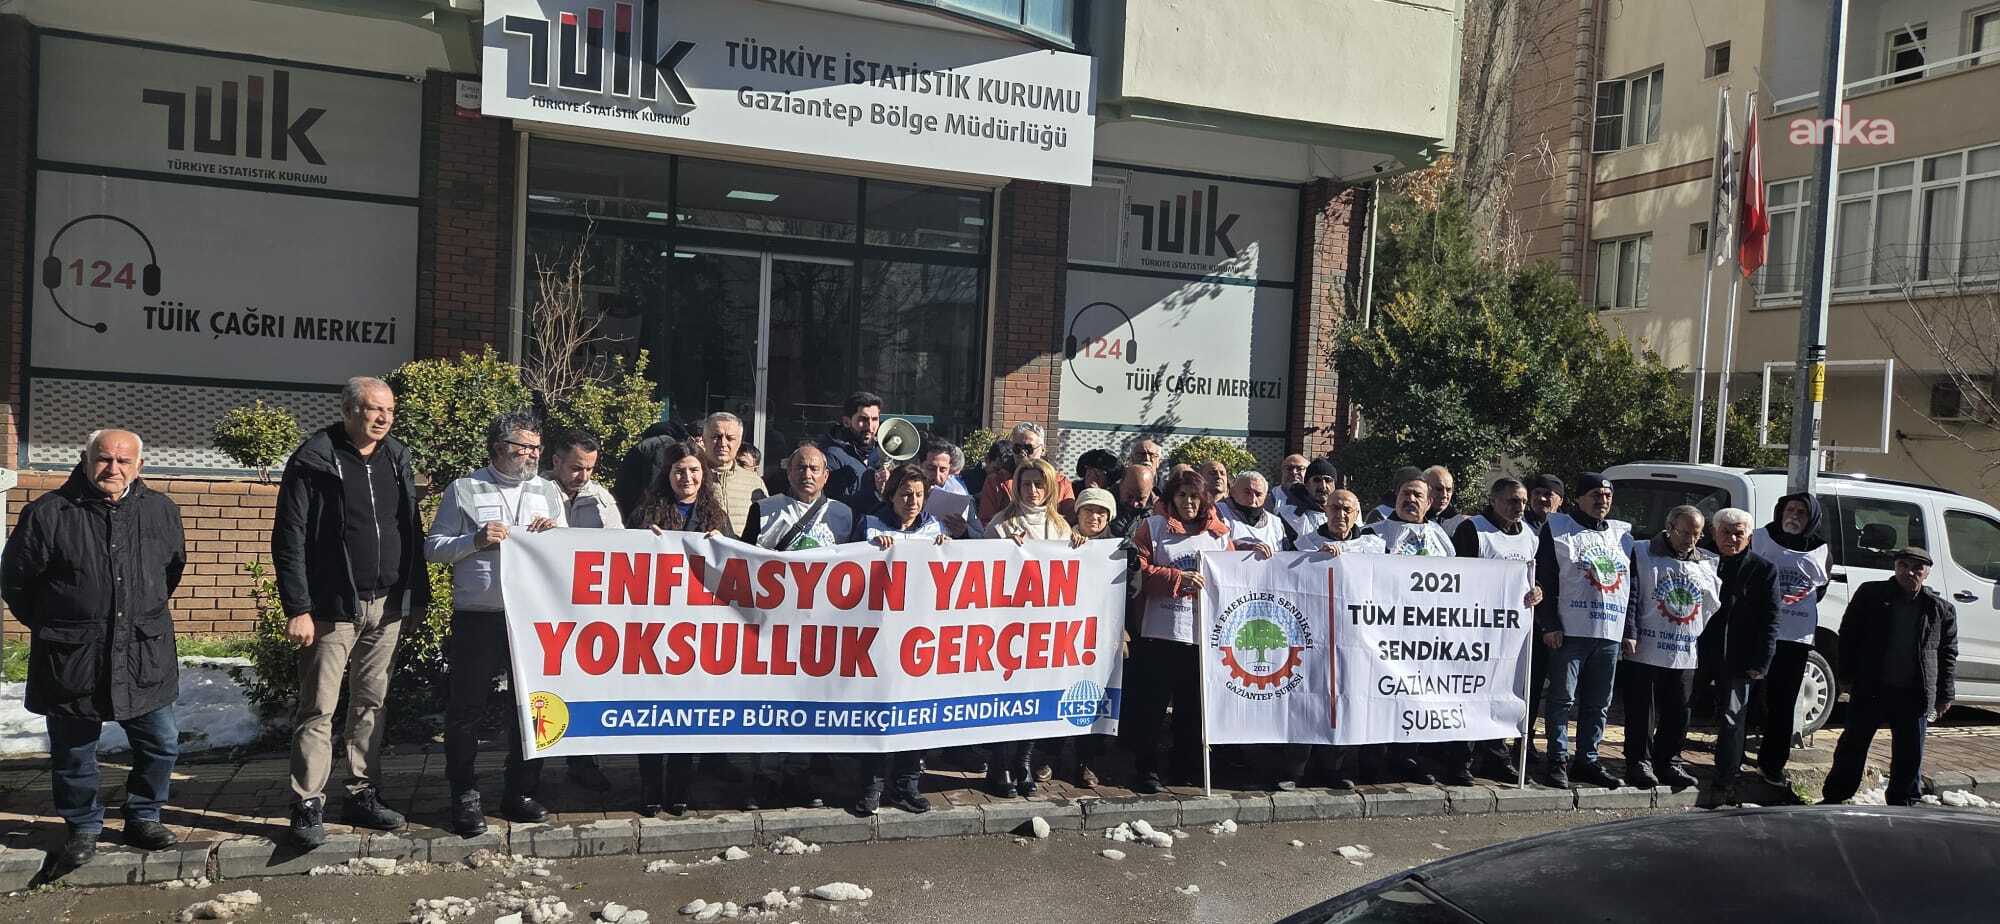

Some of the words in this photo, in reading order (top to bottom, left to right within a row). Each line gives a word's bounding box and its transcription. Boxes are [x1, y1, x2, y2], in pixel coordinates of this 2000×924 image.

[726, 39, 837, 83] TÜRKİYE
[844, 53, 970, 101] İSTATİSTİK
[977, 80, 1081, 116] KURUMU
[532, 96, 579, 113] TÜRKİYE
[642, 111, 690, 127] KURUMU
[737, 86, 863, 127] Gaziantep
[870, 104, 938, 137] Bölge
[945, 114, 1068, 151] Müdürlüğü
[167, 159, 216, 174] TÜRKİYE
[278, 171, 328, 185] KURUMU
[68, 258, 136, 290] 124
[144, 301, 200, 333] TÜİK
[210, 307, 284, 341] ÇAĞRI
[293, 317, 396, 345] MERKEZİ
[1083, 336, 1122, 360] 124
[1126, 368, 1161, 393] TÜİK
[1166, 370, 1212, 398] ÇAĞRI
[1217, 377, 1282, 400] MERKEZİ
[571, 550, 908, 612] ENFLASYON
[928, 560, 1081, 609] YALAN
[1410, 572, 1461, 593] 2021
[1211, 624, 1222, 648] TÜM
[1220, 591, 1275, 623] EMEKLİLER
[1278, 597, 1313, 649] SENDİKASI
[1347, 600, 1396, 626] TÜM
[1403, 602, 1520, 629] EMEKLİLER
[534, 621, 880, 678] YOKSULLUK
[900, 617, 1098, 681] GERÇEK!
[1378, 637, 1490, 662] SENDİKASI
[1225, 681, 1273, 701] GAZİANTEP
[1377, 671, 1486, 696] GAZİANTEP
[601, 704, 736, 729] GAZİANTEP
[743, 704, 807, 728] BÜRO
[814, 702, 938, 732] EMEKÇİLERİ
[943, 698, 1040, 723] SENDİKASI
[1059, 701, 1110, 716] KESK
[1076, 717, 1090, 726] 1995
[1401, 704, 1466, 736] ŞUBESİ
